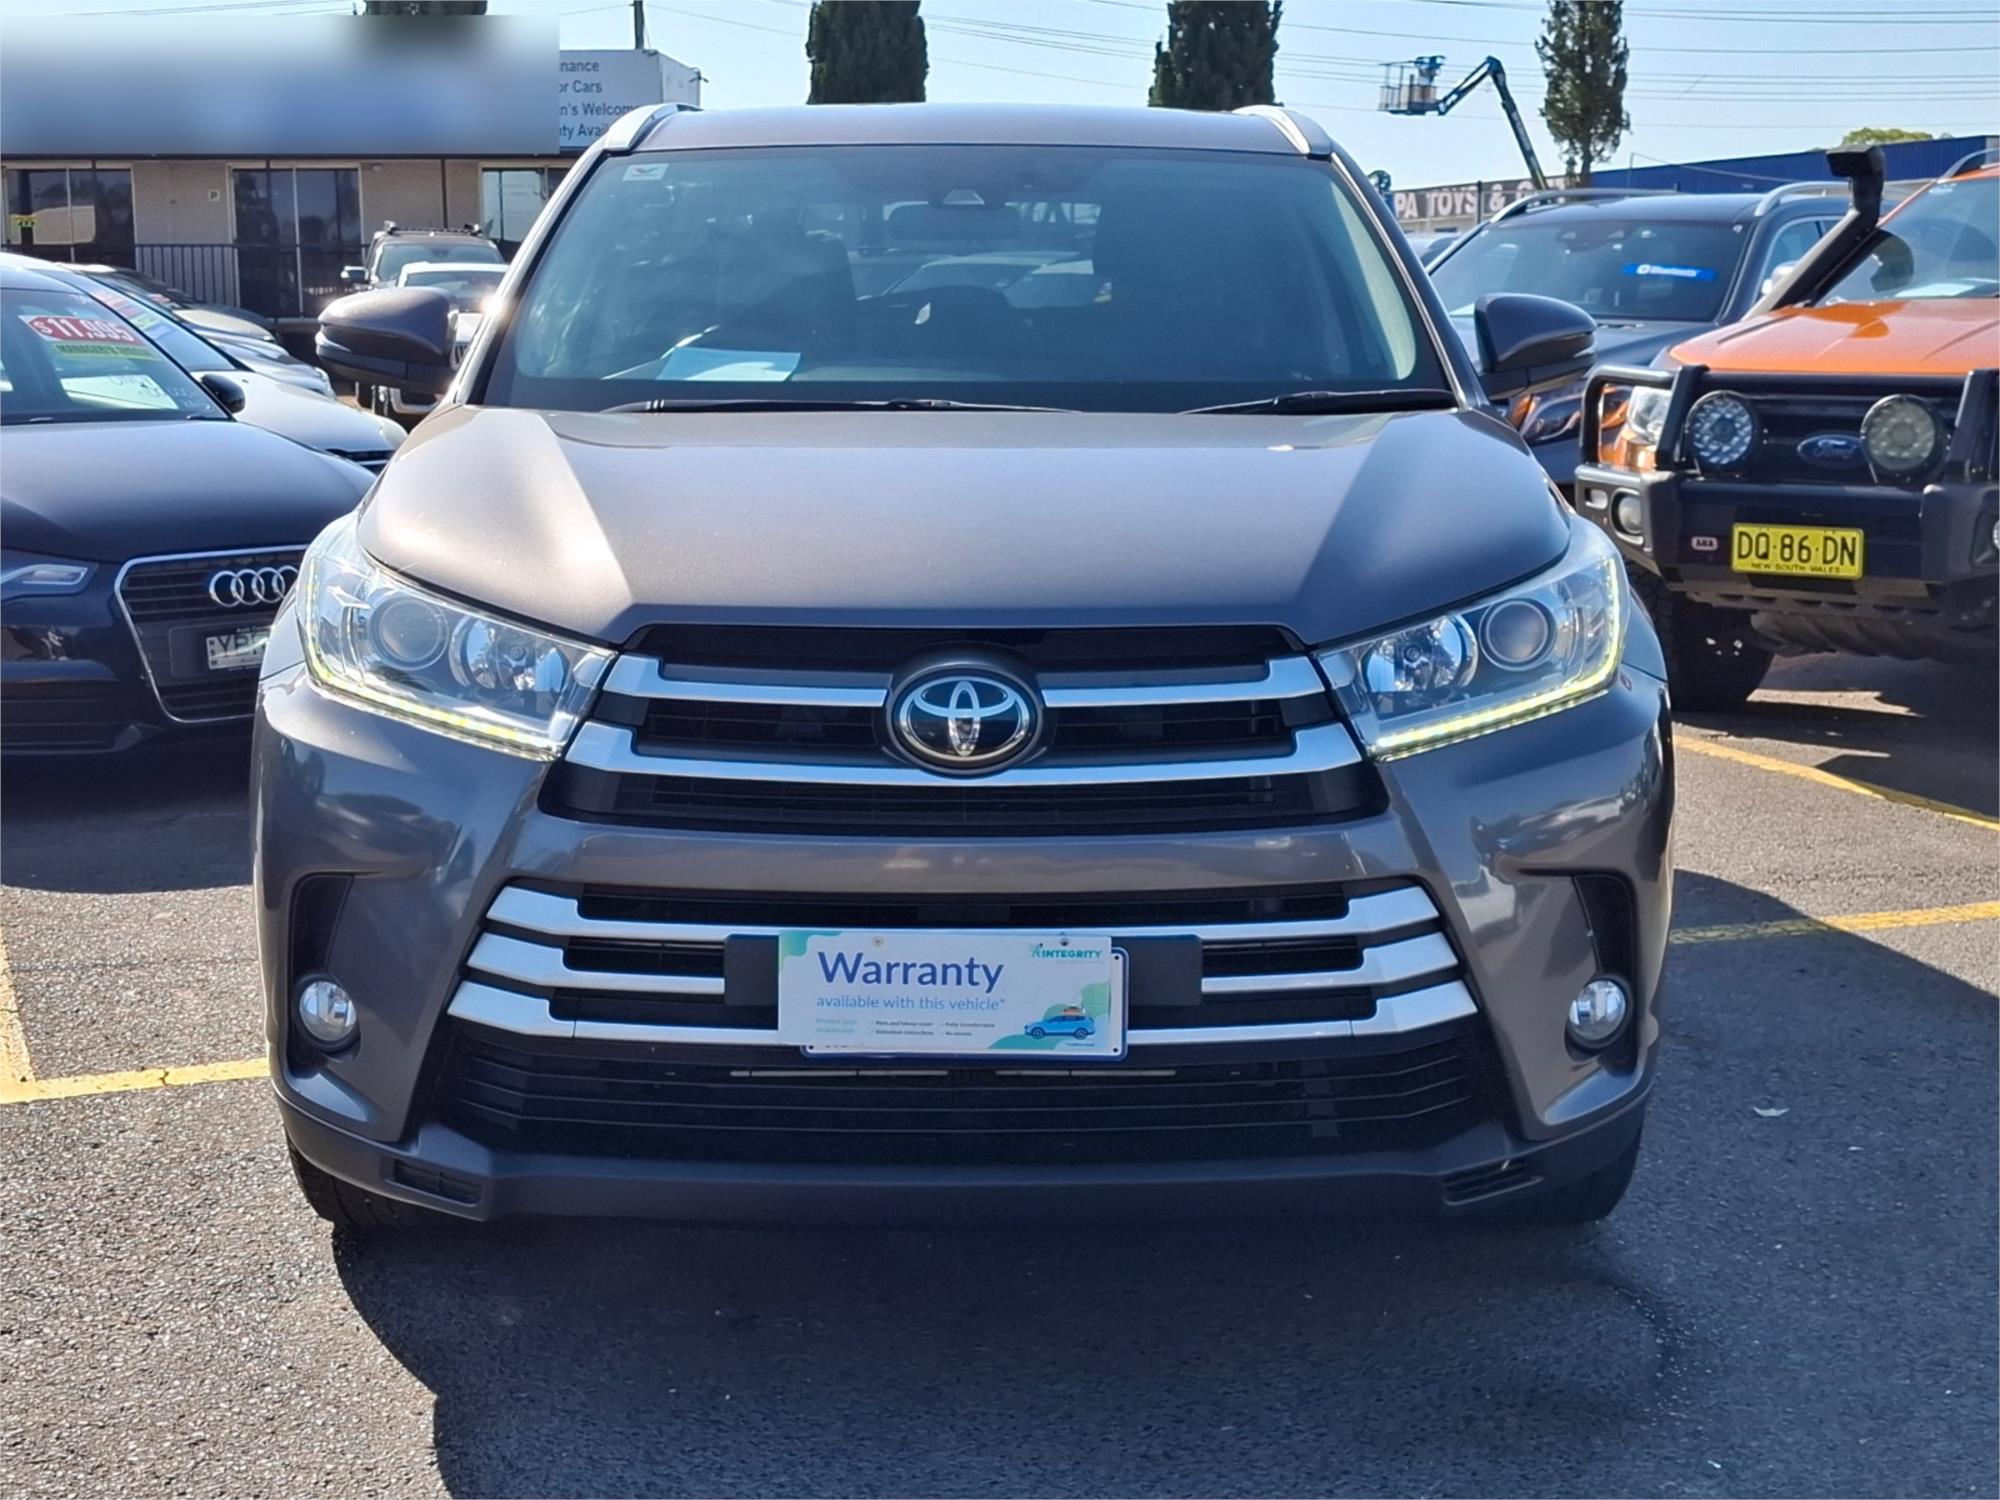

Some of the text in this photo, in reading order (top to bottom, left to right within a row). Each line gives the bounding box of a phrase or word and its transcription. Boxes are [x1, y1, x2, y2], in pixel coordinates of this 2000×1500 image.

[560, 61, 600, 73] nance
[573, 80, 603, 93] Cars
[560, 101, 637, 116] n's Welcom
[1426, 186, 1479, 216] TOYS
[1489, 183, 1506, 214] &
[32, 318, 136, 342] $11,995
[1751, 562, 1771, 570] NEW
[1810, 566, 1841, 574] WALES
[1042, 949, 1102, 959] INTEGRITY
[817, 951, 1004, 993] Warranty
[817, 995, 879, 1010] available
[883, 996, 915, 1010] with
[919, 997, 945, 1011] this
